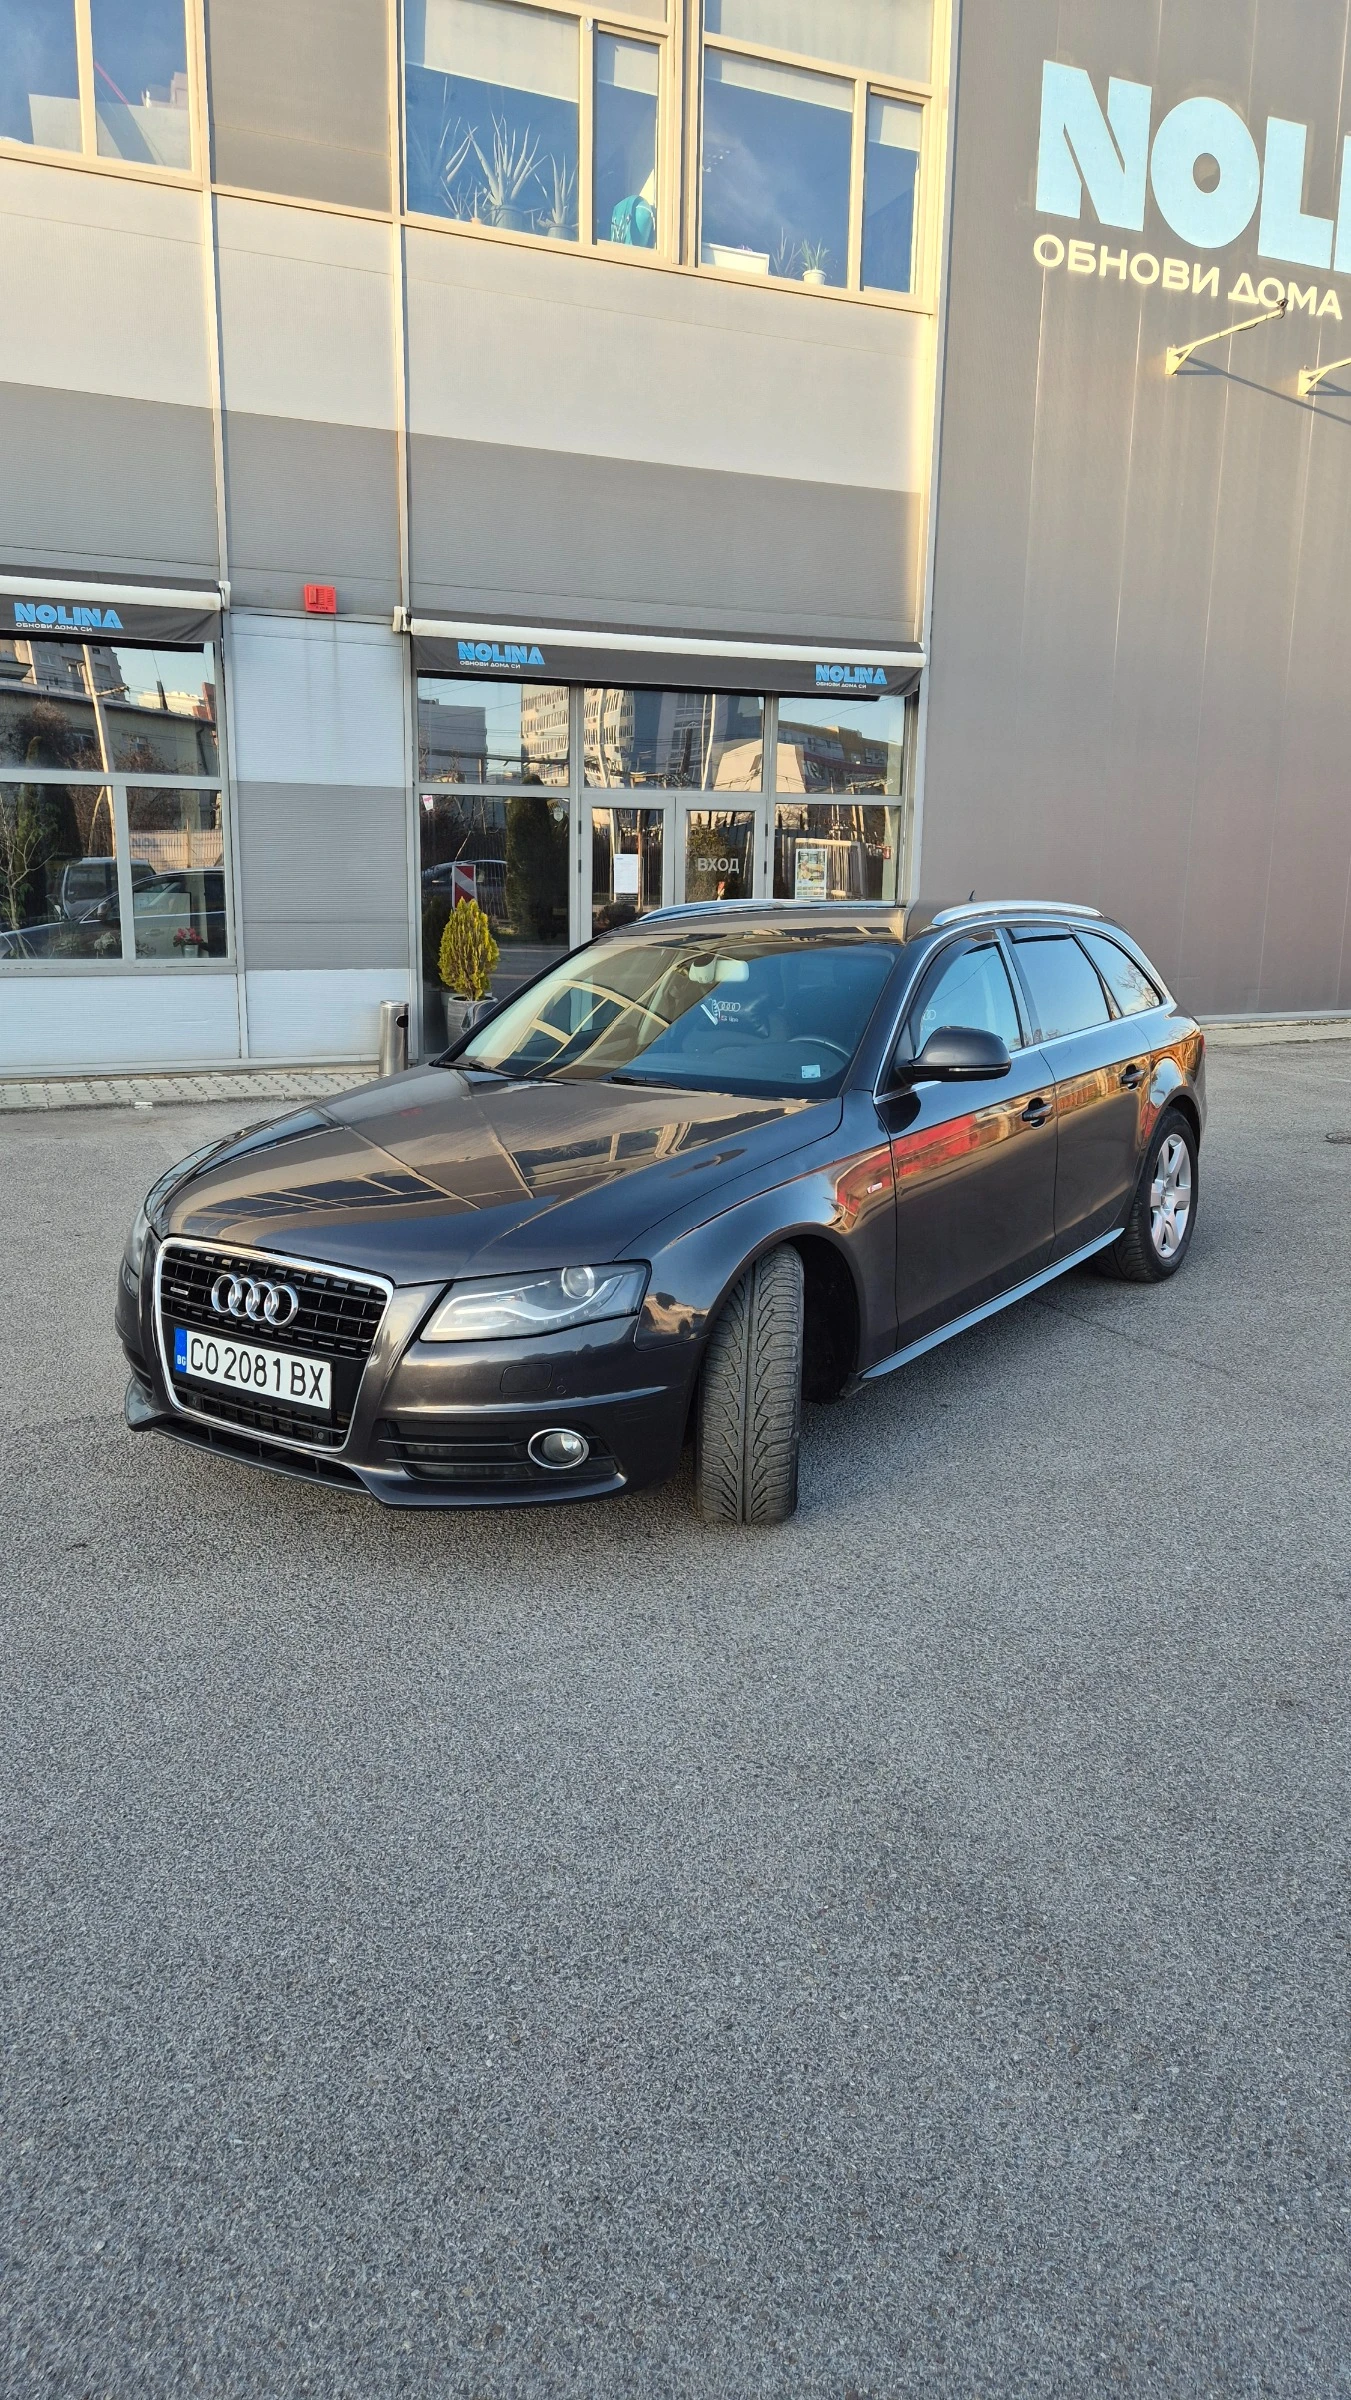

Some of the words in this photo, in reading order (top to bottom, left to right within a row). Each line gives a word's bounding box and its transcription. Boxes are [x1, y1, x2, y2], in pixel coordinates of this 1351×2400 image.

[1033, 234, 1219, 297] ОБНОВИ
[1228, 272, 1343, 320] ДОМА
[14, 602, 124, 629] NOLINA
[54, 624, 78, 632] ДОМА
[457, 641, 545, 665] NOLINA
[815, 664, 887, 685] NOLINA
[698, 858, 739, 873] ВХОД
[177, 1355, 186, 1365] BG
